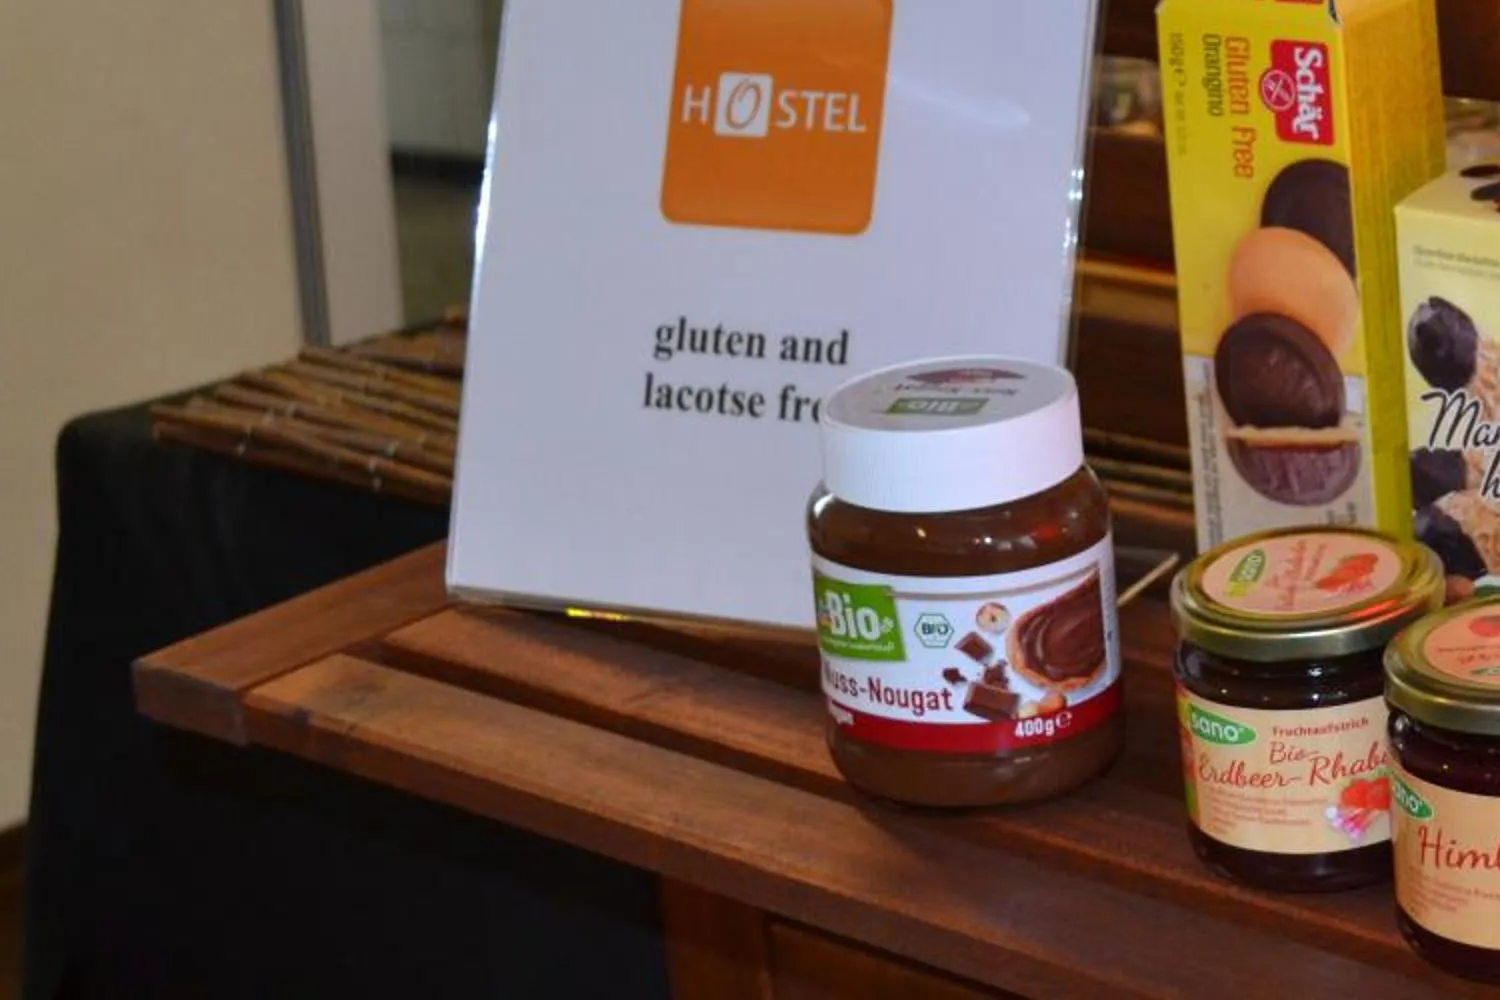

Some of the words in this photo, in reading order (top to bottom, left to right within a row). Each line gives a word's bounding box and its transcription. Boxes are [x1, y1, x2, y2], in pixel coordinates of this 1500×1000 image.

[1202, 33, 1225, 117] Orangino
[1225, 36, 1252, 115] Gluten
[1292, 46, 1325, 140] Schär
[681, 74, 867, 135] HOSTEL
[1232, 125, 1258, 180] Free
[653, 315, 766, 362] gluten
[779, 328, 849, 366] and
[643, 371, 766, 419] lacotse
[921, 623, 948, 636] BIO
[1271, 717, 1369, 737] Fruchtaufstrich
